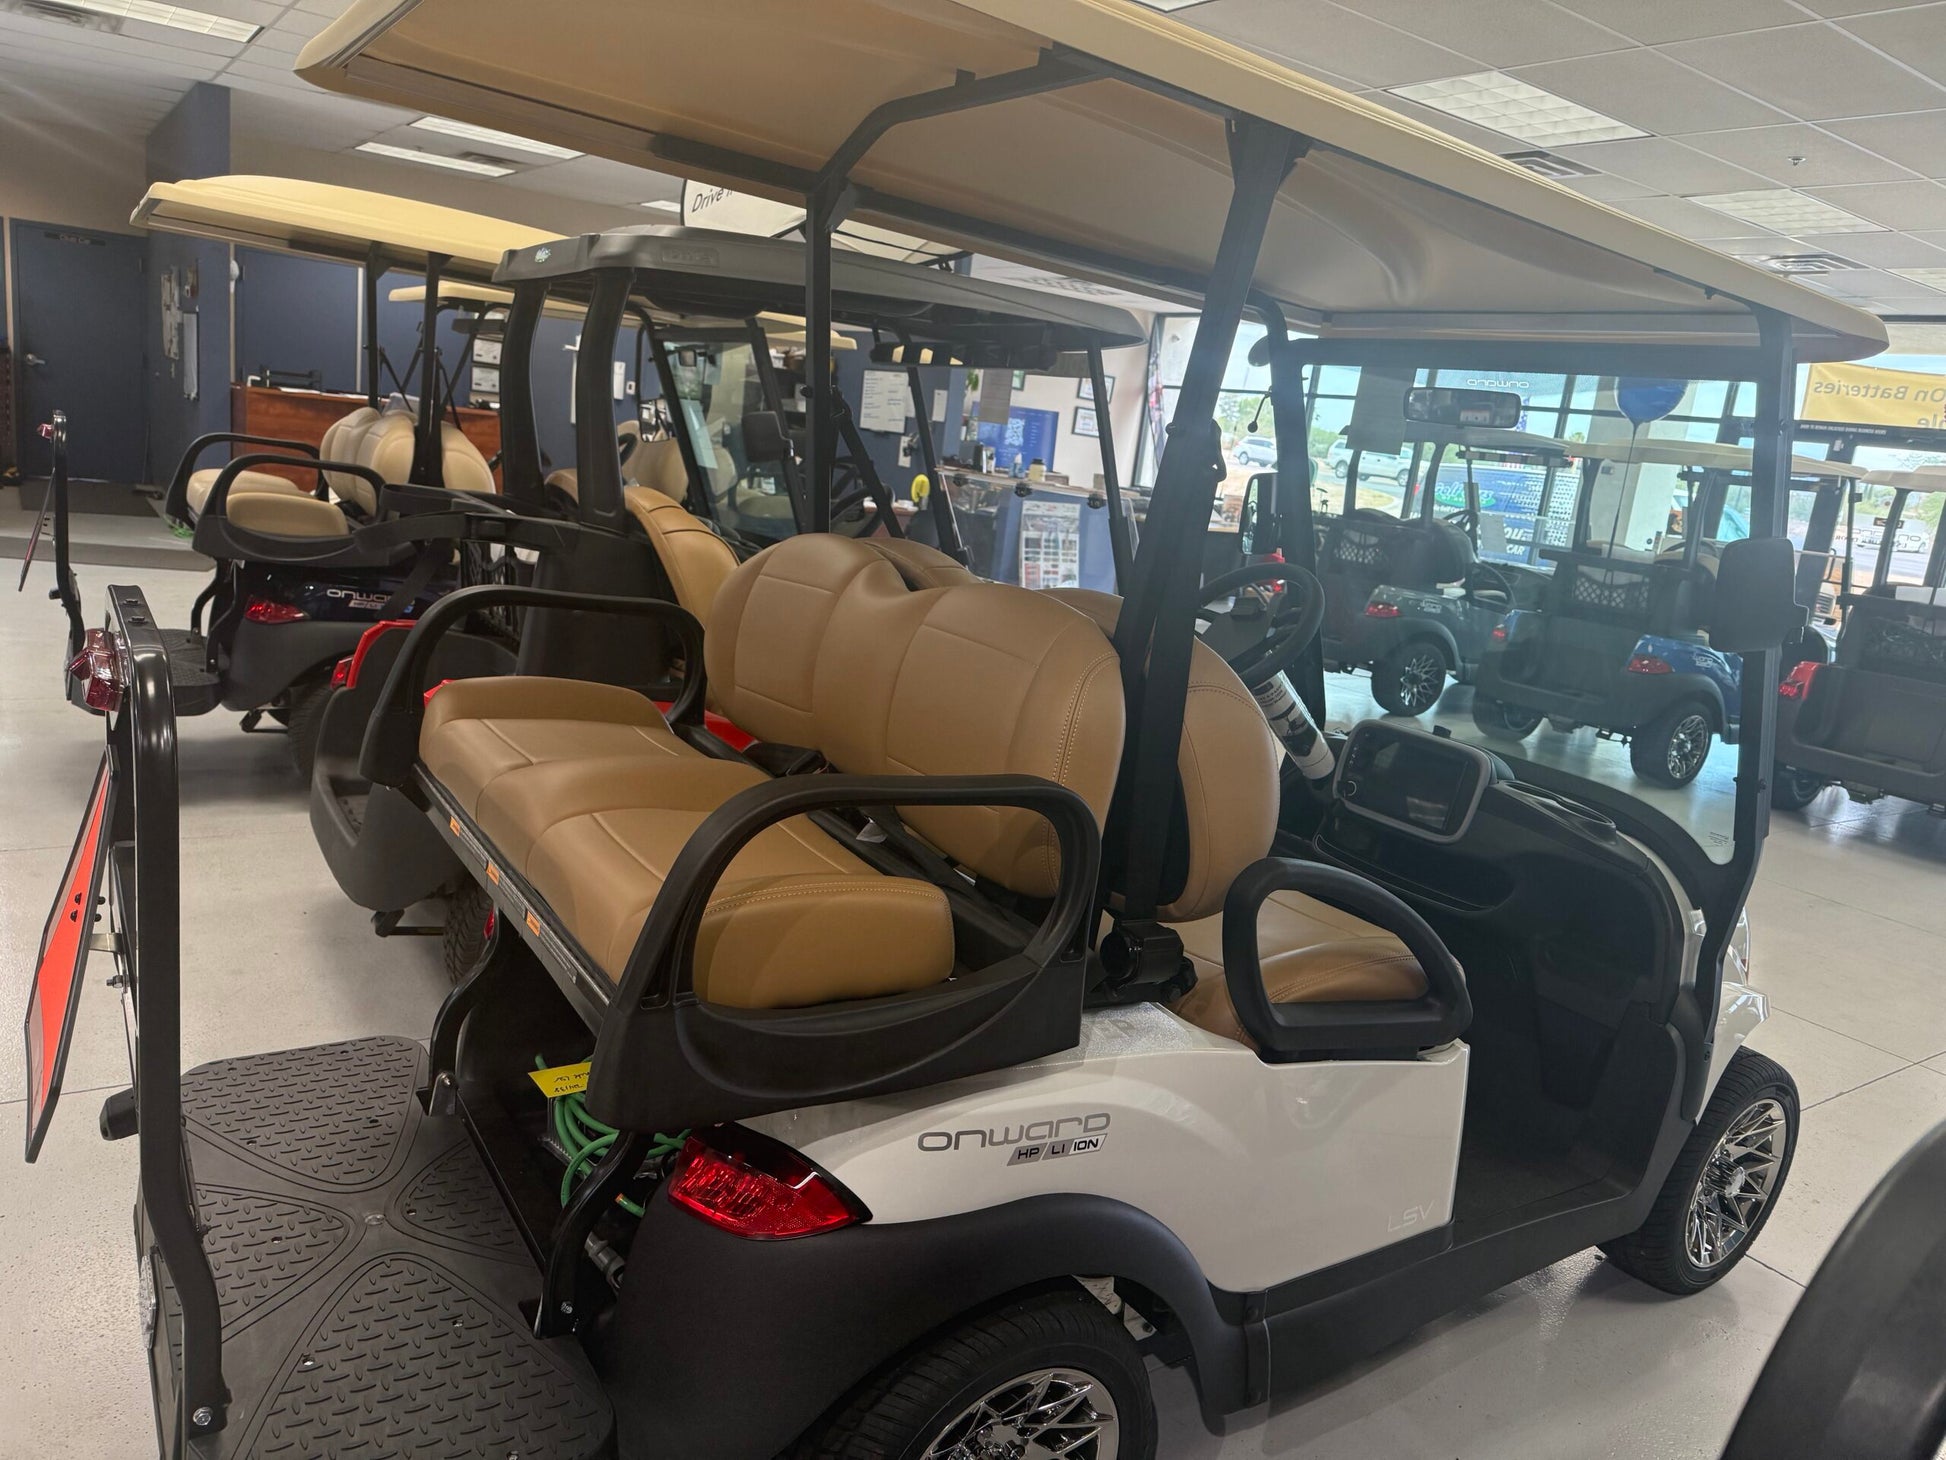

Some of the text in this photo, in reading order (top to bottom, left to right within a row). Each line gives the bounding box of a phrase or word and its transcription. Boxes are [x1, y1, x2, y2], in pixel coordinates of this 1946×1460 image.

[691, 187, 724, 213] Drive
[917, 1112, 1111, 1152] onward
[1017, 1137, 1100, 1161] HP LI ION
[1387, 1199, 1435, 1232] LSV
